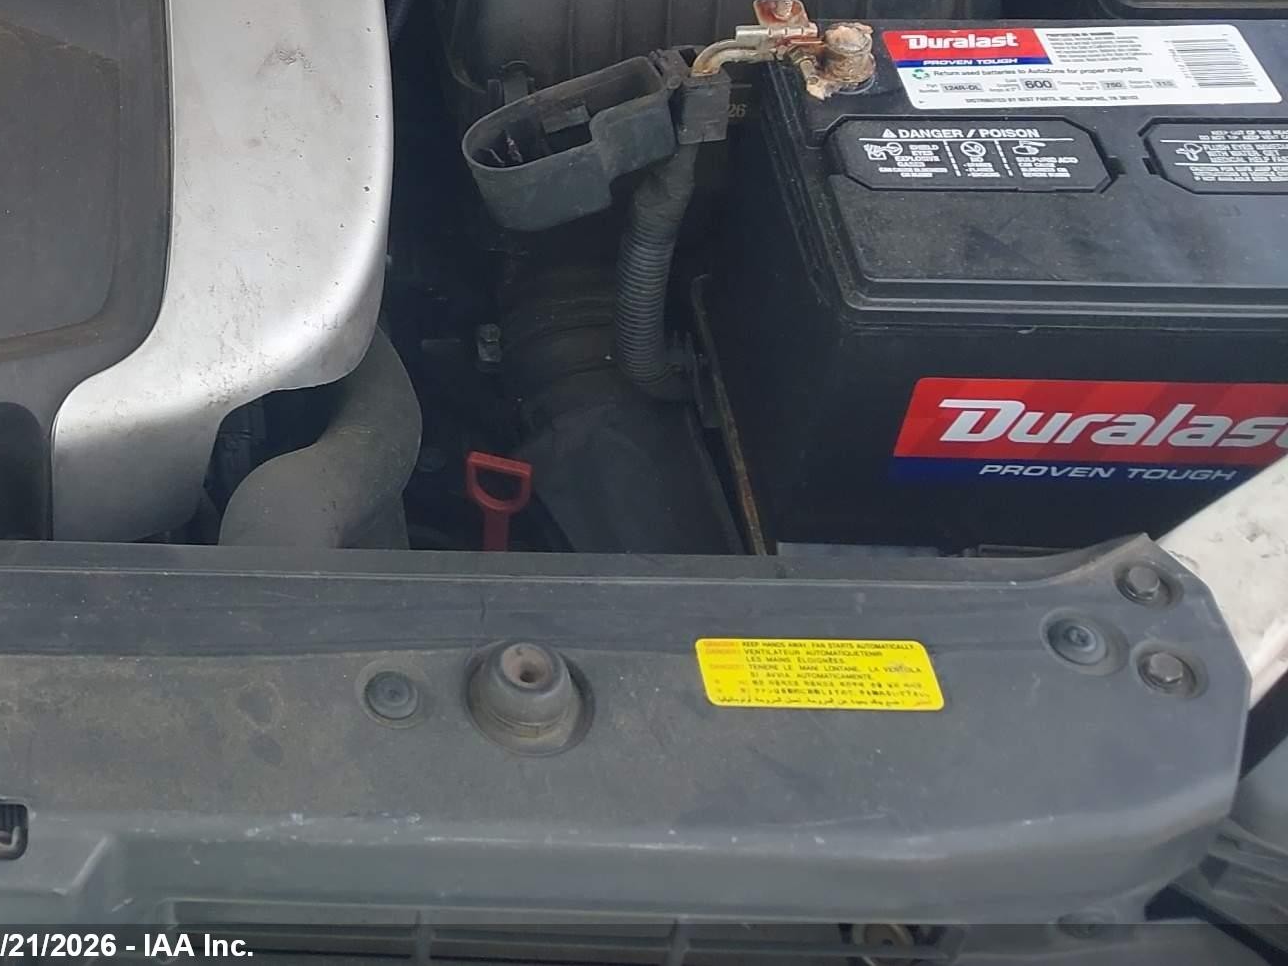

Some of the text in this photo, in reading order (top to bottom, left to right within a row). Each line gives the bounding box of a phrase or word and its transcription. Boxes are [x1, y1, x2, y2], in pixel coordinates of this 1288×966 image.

[901, 33, 1019, 50] Duralast
[1028, 67, 1065, 75] AutoZone
[1107, 66, 1144, 74] recycling
[1024, 79, 1053, 90] 600
[898, 129, 964, 139] DANGER
[979, 129, 1040, 138] POISON
[978, 464, 1237, 481] PROVEN TOUGH
